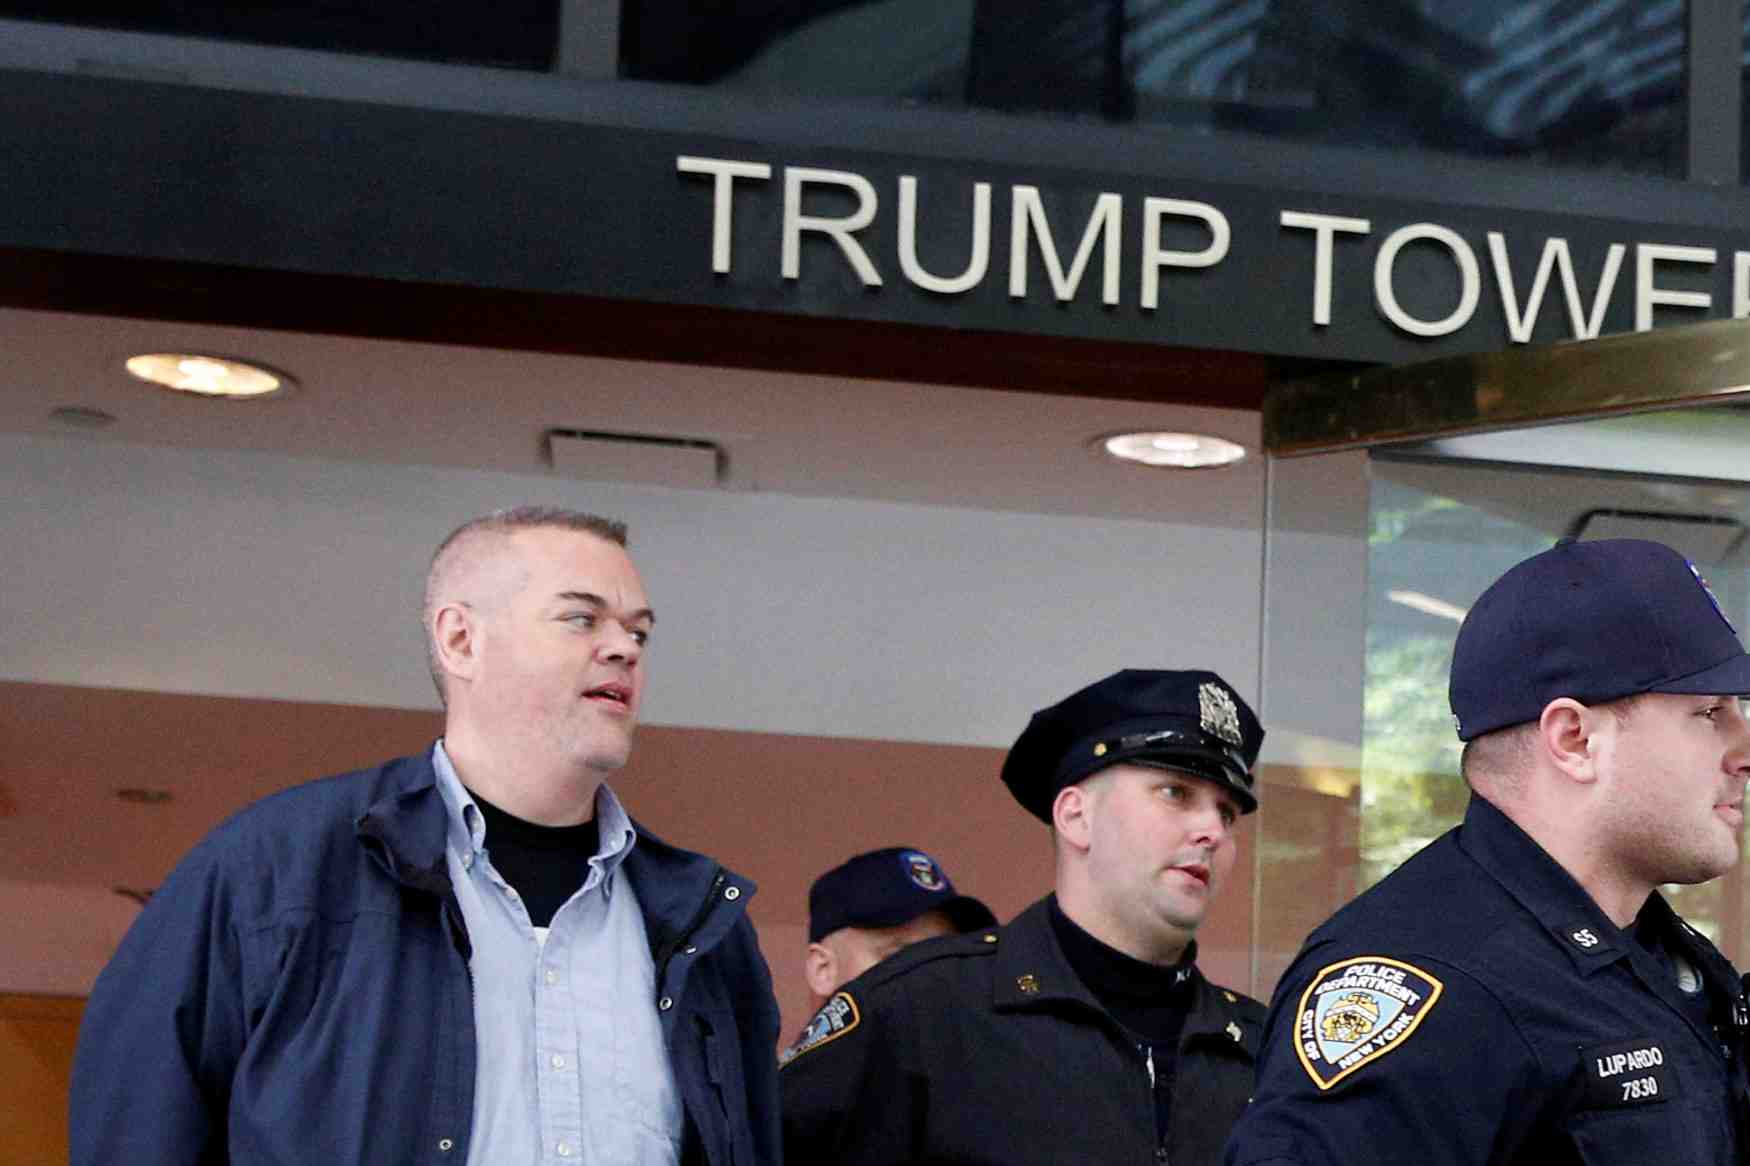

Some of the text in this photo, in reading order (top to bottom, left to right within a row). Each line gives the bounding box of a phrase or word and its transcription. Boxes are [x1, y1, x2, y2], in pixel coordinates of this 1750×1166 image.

[677, 156, 1231, 310] TRUMP
[1344, 963, 1407, 985] POLICE
[1314, 975, 1421, 1006] DEPARTMENT
[1301, 1009, 1321, 1061] CITY OF
[1338, 1012, 1414, 1069] NEW YORK
[1597, 1046, 1664, 1078] LUPARDO
[1621, 1076, 1658, 1102] 7830
